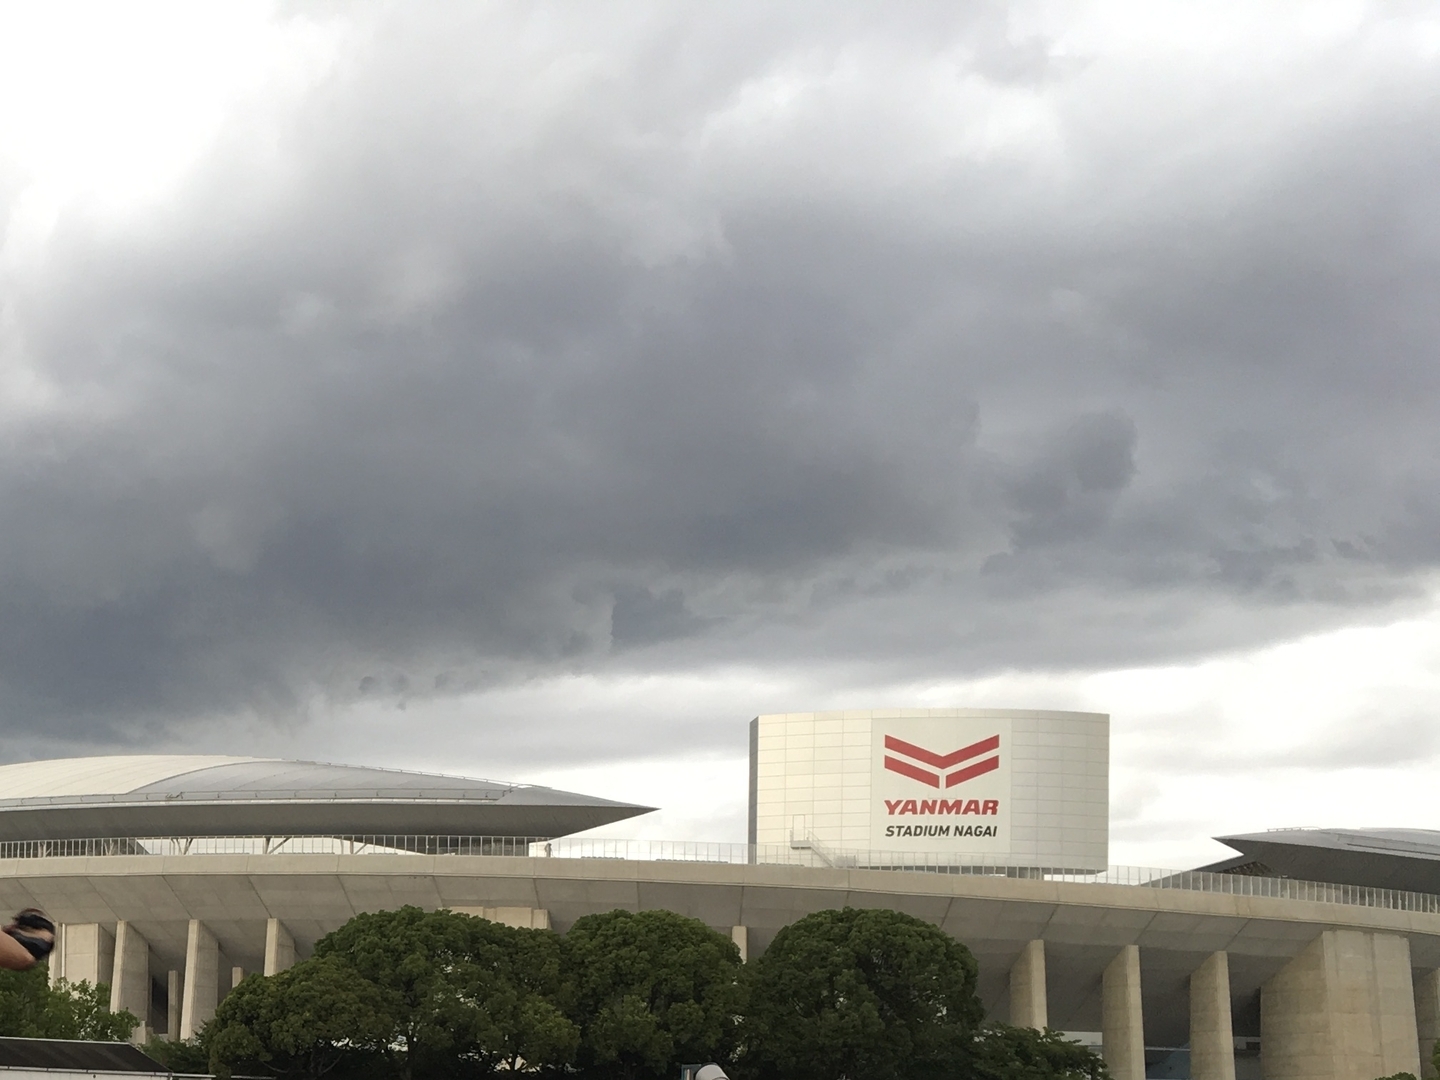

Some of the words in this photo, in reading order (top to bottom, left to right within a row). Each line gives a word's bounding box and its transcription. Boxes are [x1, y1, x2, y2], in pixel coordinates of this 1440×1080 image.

[884, 799, 999, 816] YANMAR
[885, 825, 951, 837] STADIUM
[953, 825, 998, 837] NAGAI
